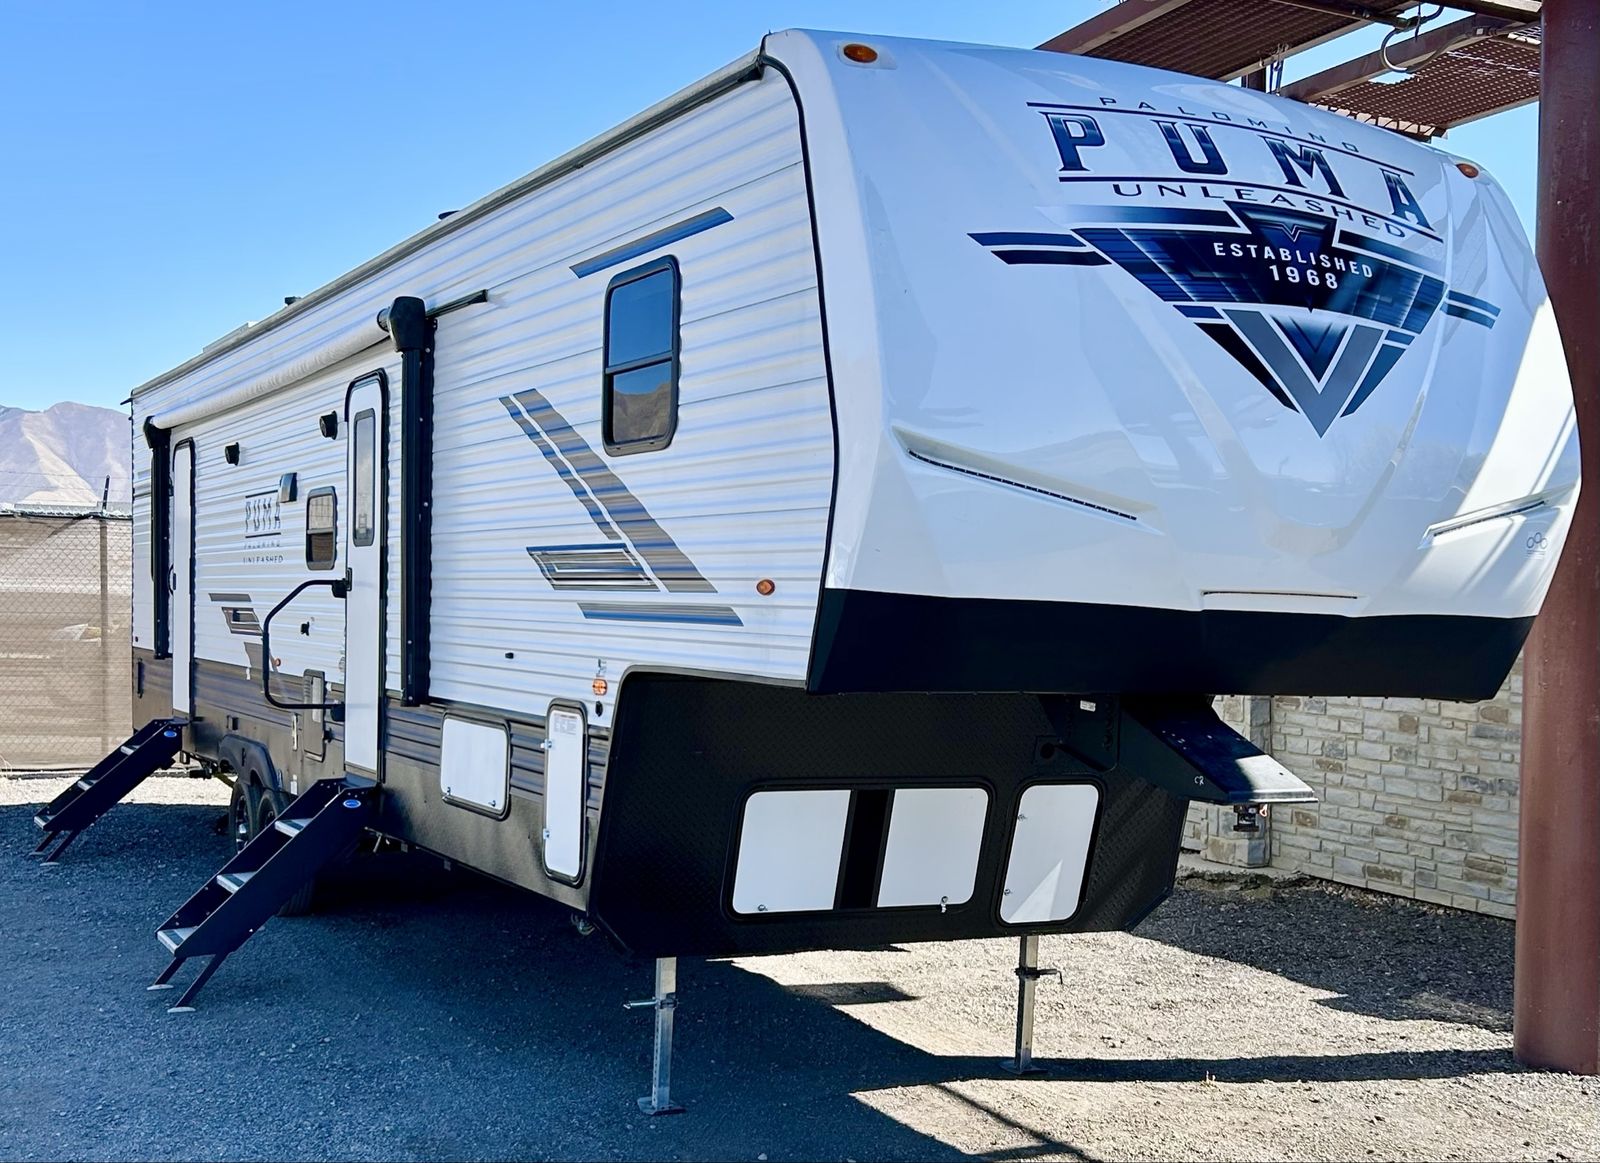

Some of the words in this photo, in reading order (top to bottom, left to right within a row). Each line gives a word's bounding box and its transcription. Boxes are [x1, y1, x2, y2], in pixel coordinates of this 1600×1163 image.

[1099, 96, 1360, 153] PALOMINO
[1041, 111, 1435, 231] PUMA
[1112, 183, 1406, 238] UNLEASHED
[1213, 242, 1373, 278] ESTABLISHED
[1269, 264, 1338, 289] 1968
[244, 497, 281, 533] PUMA
